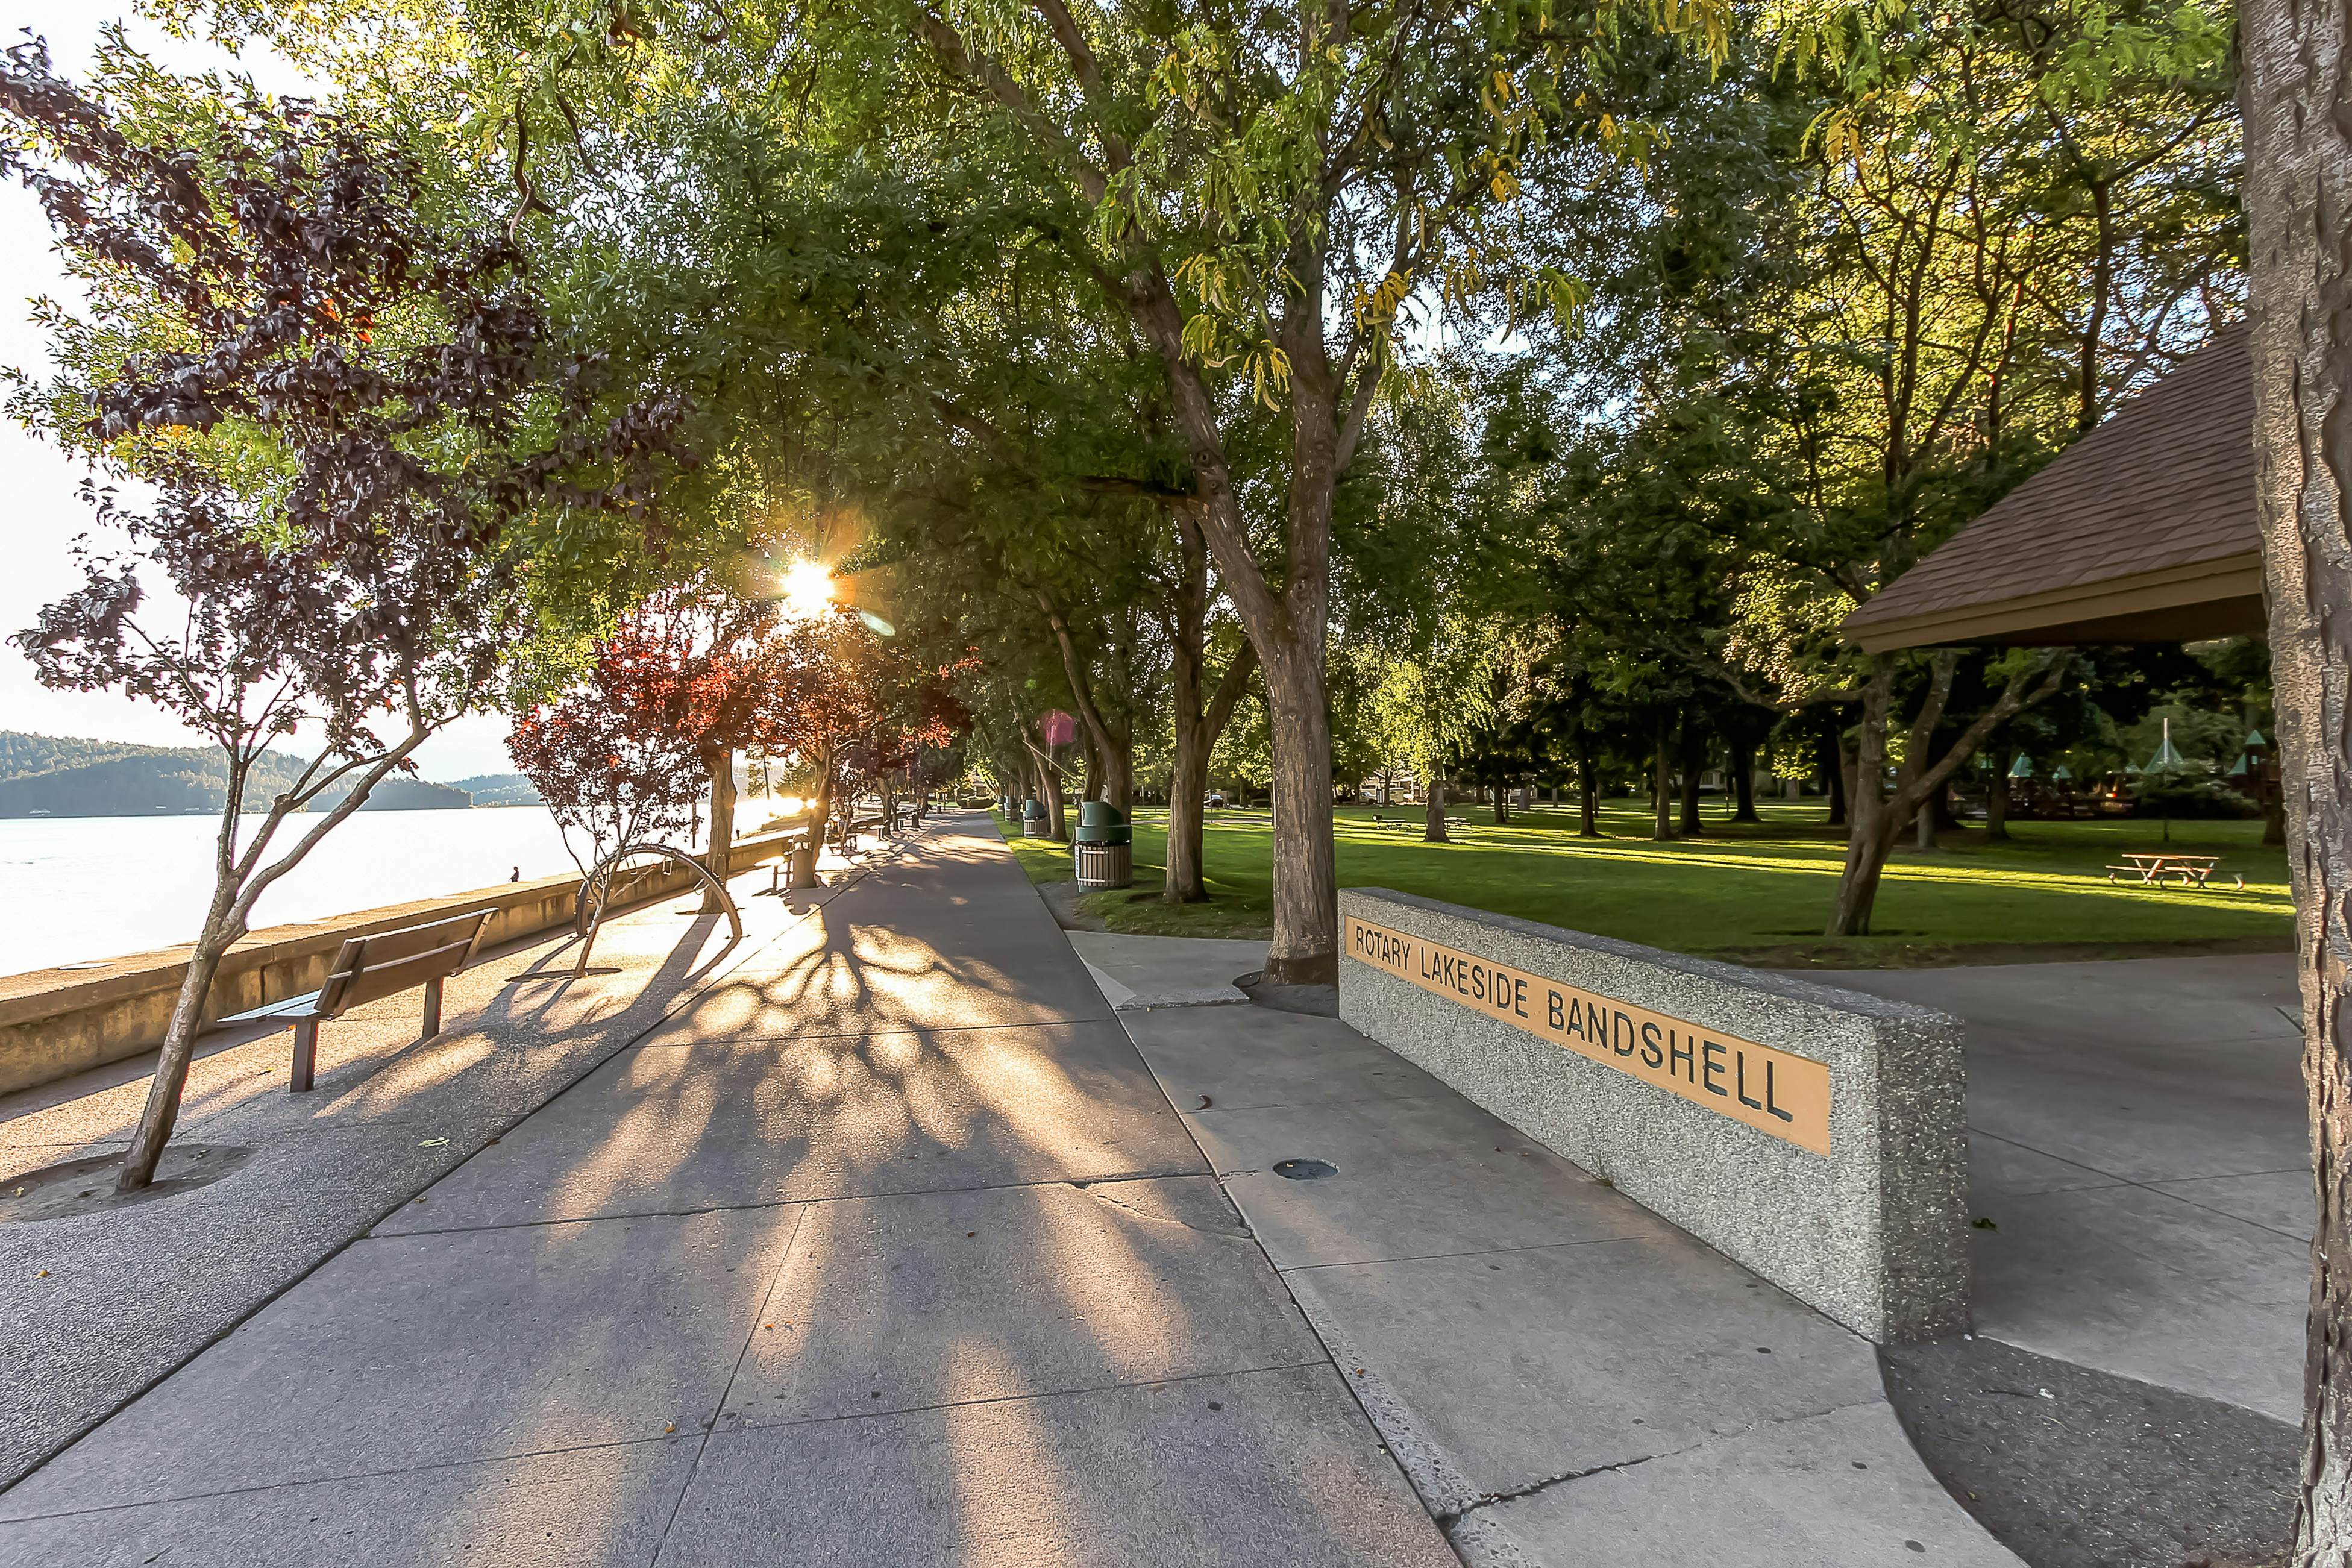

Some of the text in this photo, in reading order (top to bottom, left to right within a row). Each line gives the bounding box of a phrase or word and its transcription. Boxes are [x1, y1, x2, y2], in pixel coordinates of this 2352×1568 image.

[1356, 926, 1793, 1122] ROTARY LAKESIDE BANDSHELL
